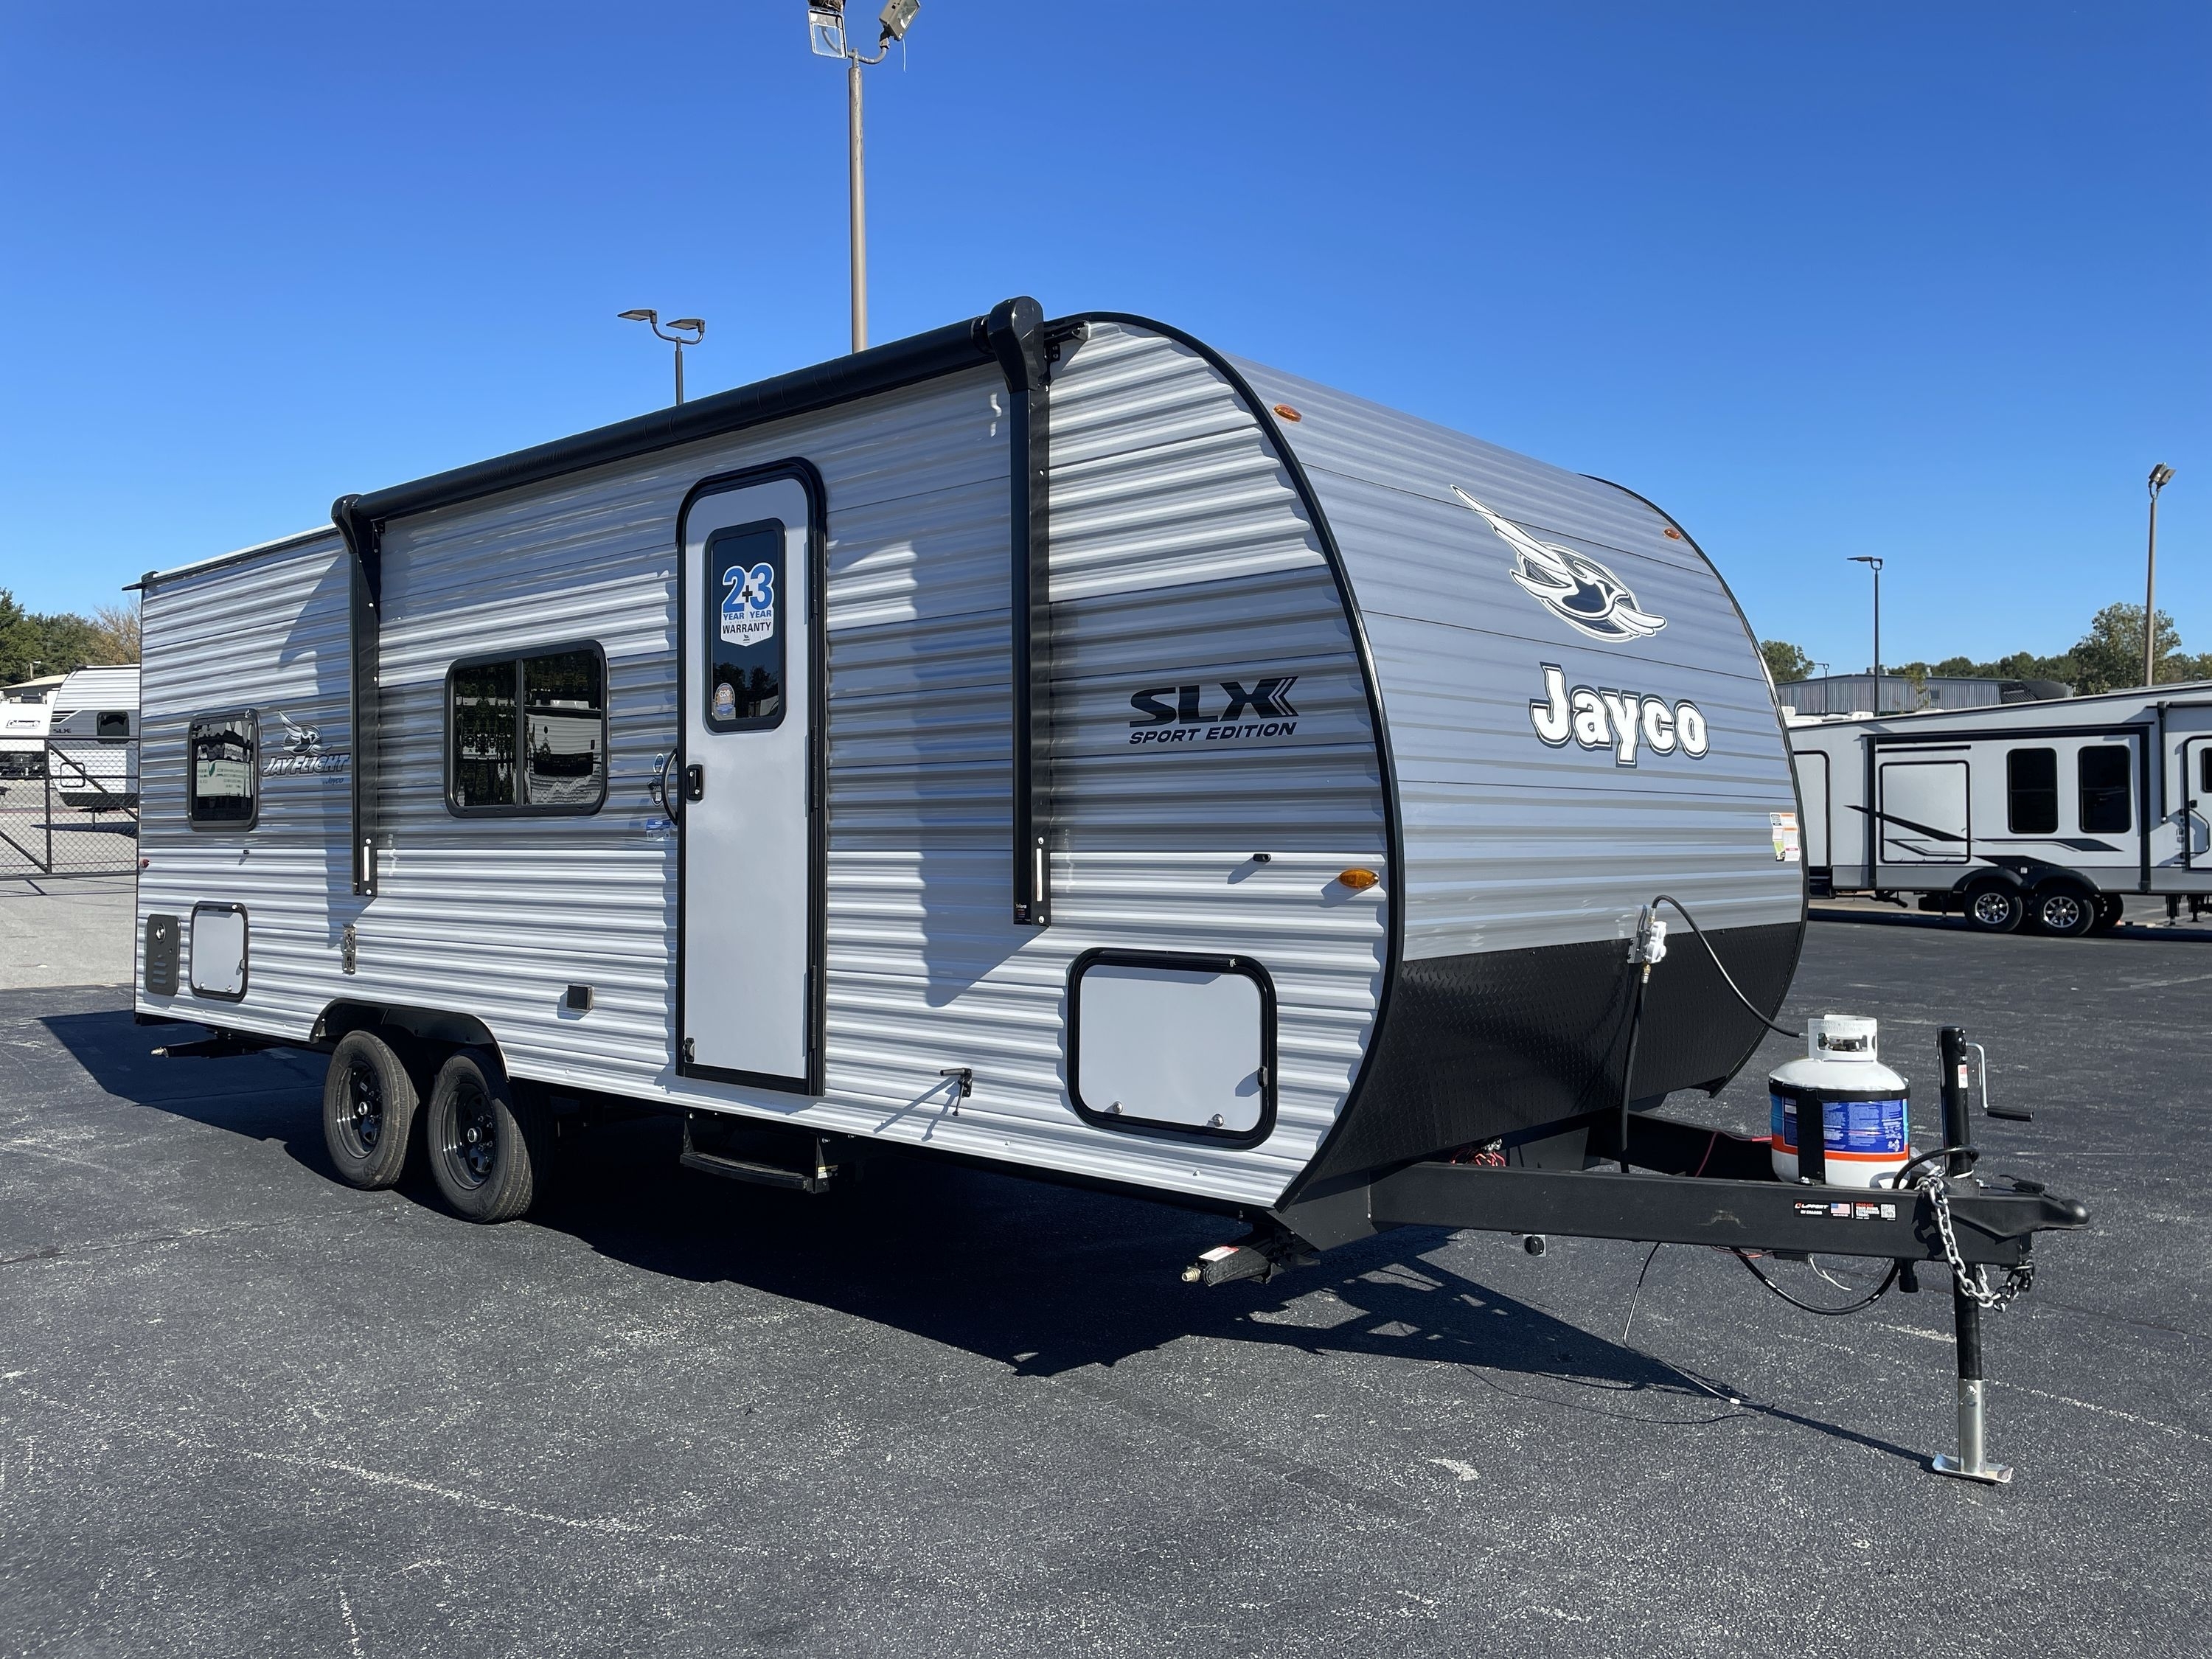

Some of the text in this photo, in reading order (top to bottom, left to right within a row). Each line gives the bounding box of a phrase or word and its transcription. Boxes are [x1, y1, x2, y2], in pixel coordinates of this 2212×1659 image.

[723, 610, 772, 621] YEAR YEAR
[723, 622, 772, 634] WARRANTY
[1130, 676, 1299, 728] SLX
[1529, 661, 1710, 768] Jayco
[1129, 722, 1297, 745] SPORT EDITION
[262, 753, 351, 776] JAY FLIGHT
